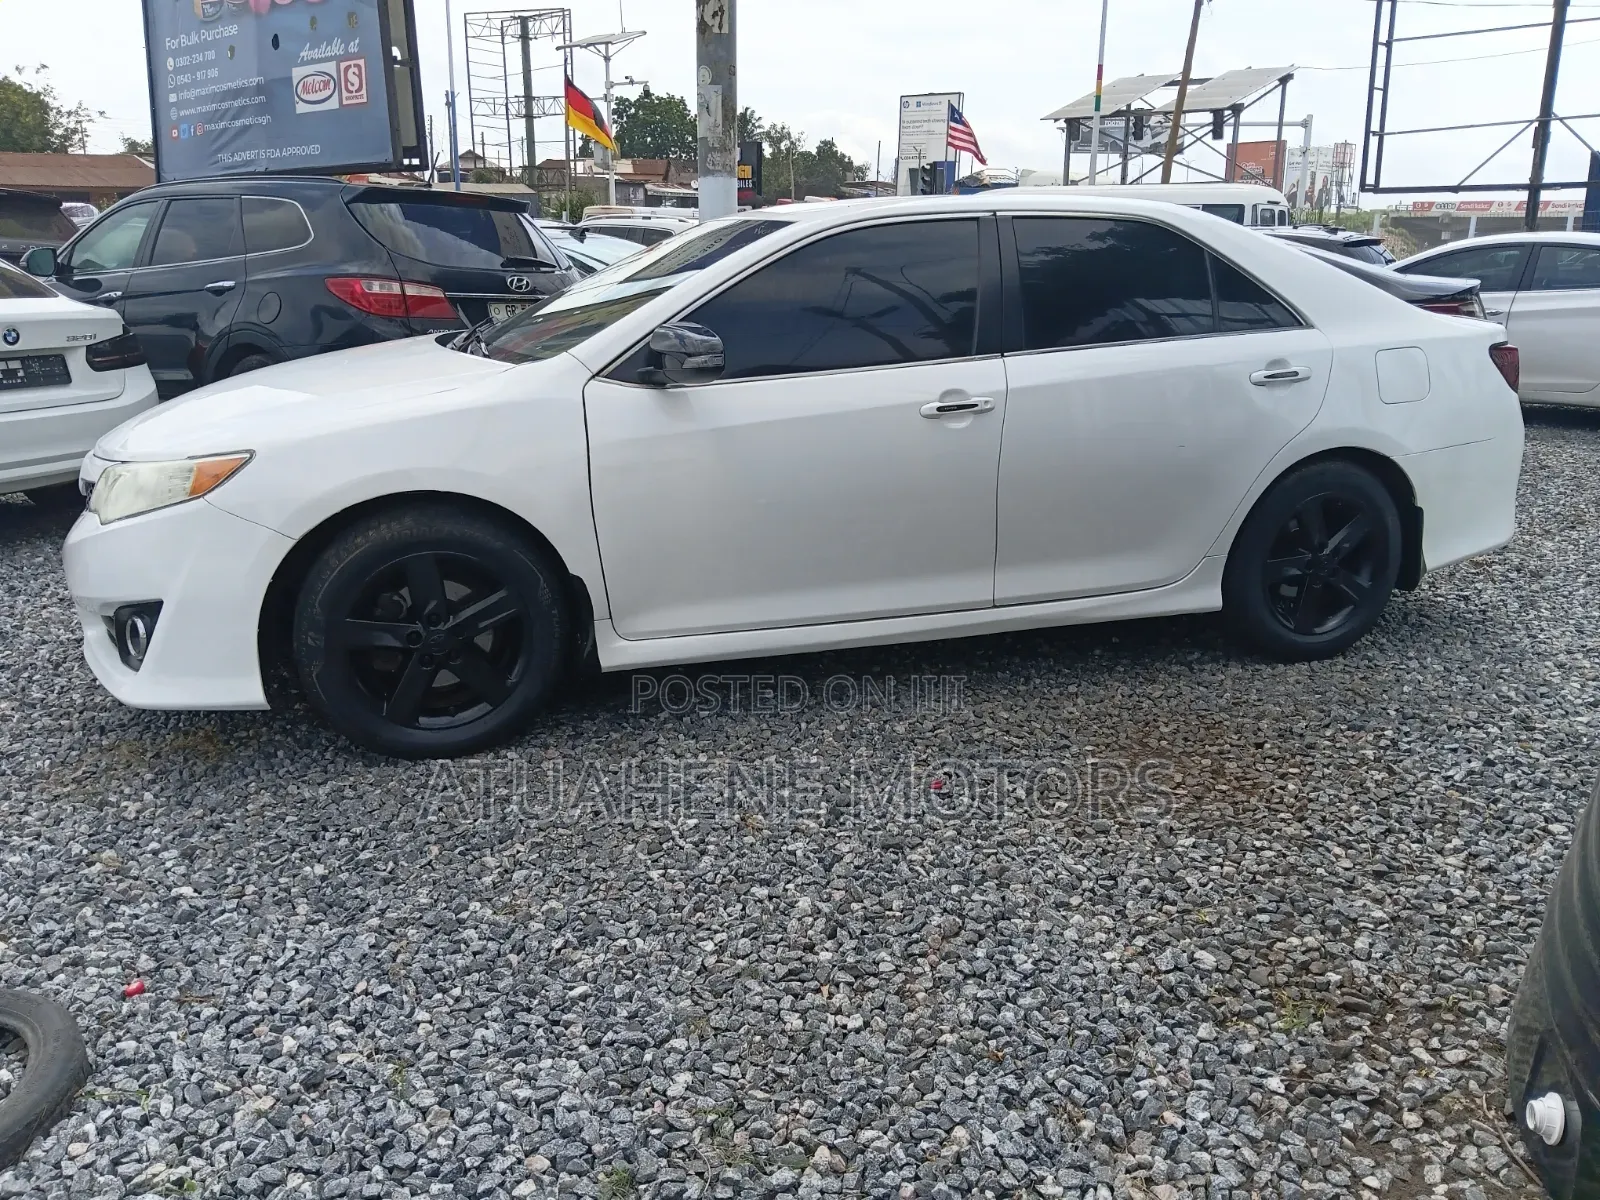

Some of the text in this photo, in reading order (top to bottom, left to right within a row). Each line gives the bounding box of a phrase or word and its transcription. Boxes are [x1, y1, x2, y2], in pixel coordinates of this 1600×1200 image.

[166, 24, 238, 50] For Bulk Purchase
[298, 37, 360, 63] Available at
[178, 76, 265, 100] info@maximcosmetics.com
[300, 78, 331, 96] Melcom
[179, 95, 267, 117] www.maximcosmetics.com
[204, 114, 272, 132] maximcosmeticsgh
[217, 144, 321, 163] THIS ADVERT IS FDA APPROVED
